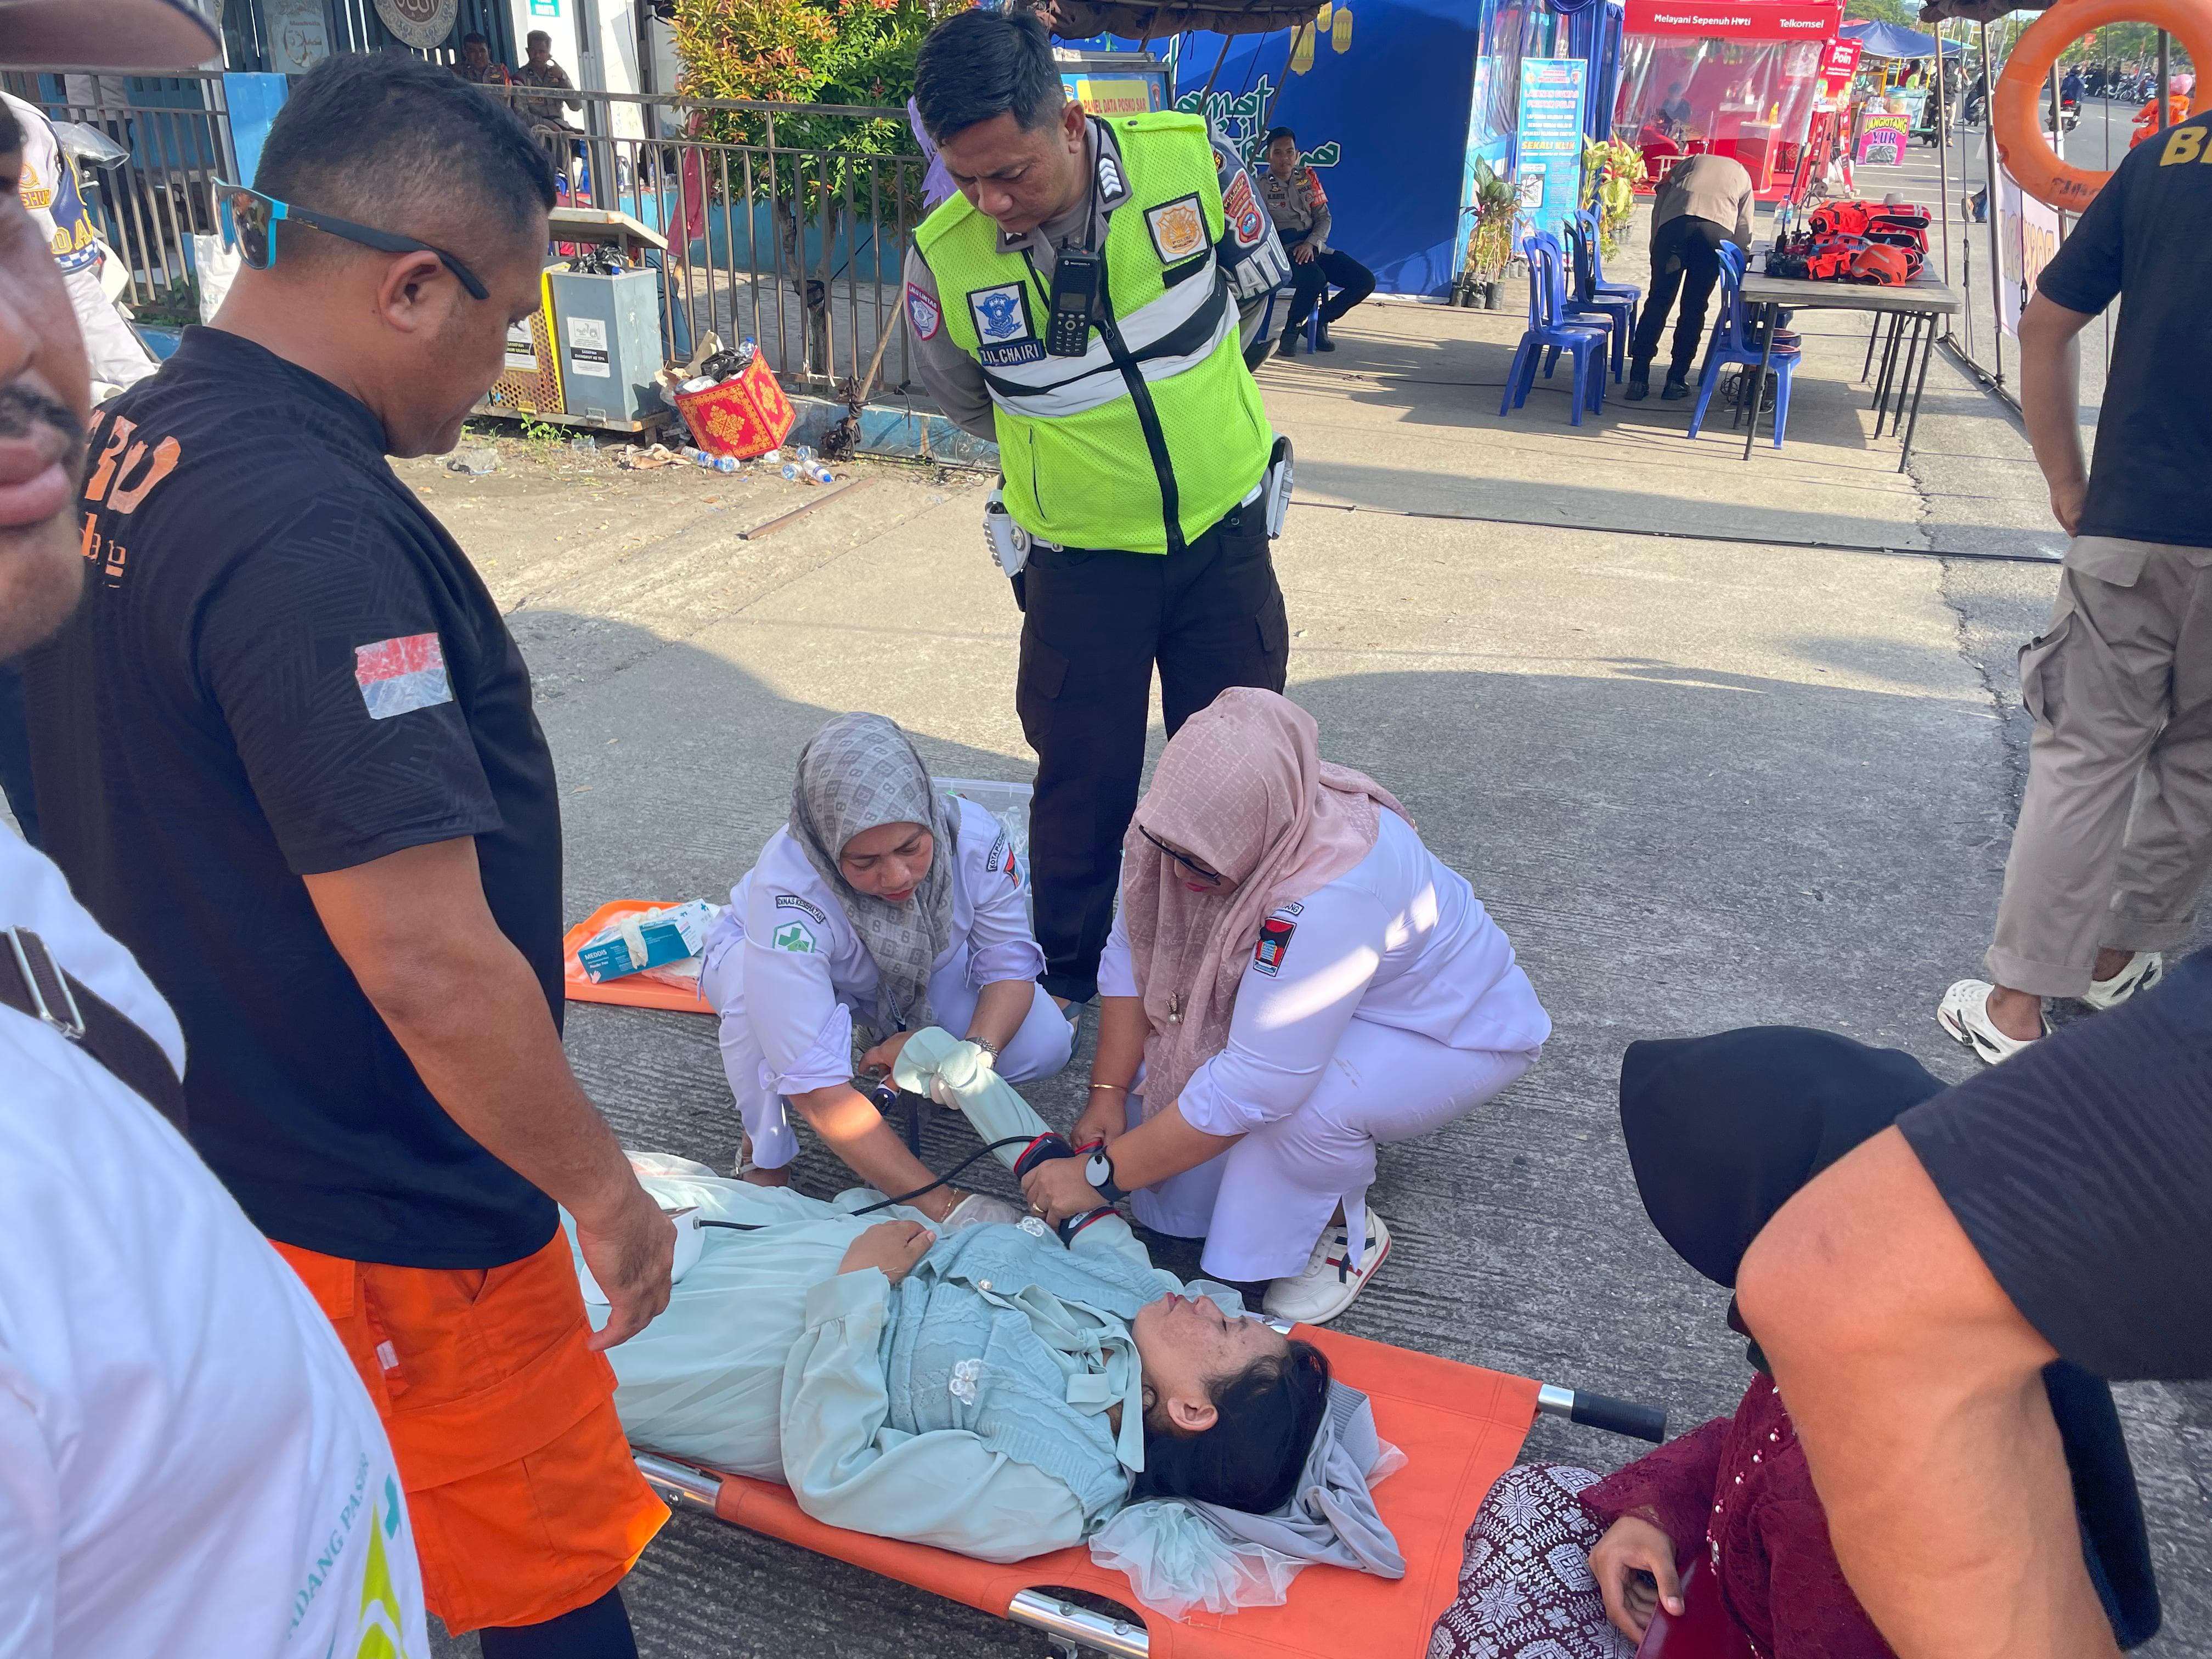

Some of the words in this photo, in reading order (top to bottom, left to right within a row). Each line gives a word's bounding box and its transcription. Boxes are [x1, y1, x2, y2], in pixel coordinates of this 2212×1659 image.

[1654, 14, 1691, 25] Melayani
[1692, 15, 1730, 26] Sepenuh
[1780, 19, 1824, 28] Telkomsel
[1832, 52, 1852, 64] Poin
[1084, 98, 1103, 114] PANEL
[1103, 99, 1118, 113] DATA
[1119, 98, 1135, 112] POSKO
[1136, 98, 1146, 111] SAR
[1864, 117, 1908, 135] LANGKITANG
[1522, 141, 1554, 150] SEKALI
[2159, 126, 2212, 167] B
[1000, 343, 1039, 364] CHAIRI
[990, 852, 998, 868] KOTA
[795, 899, 823, 921] KESEHATAN
[584, 949, 607, 960] MEDDIS
